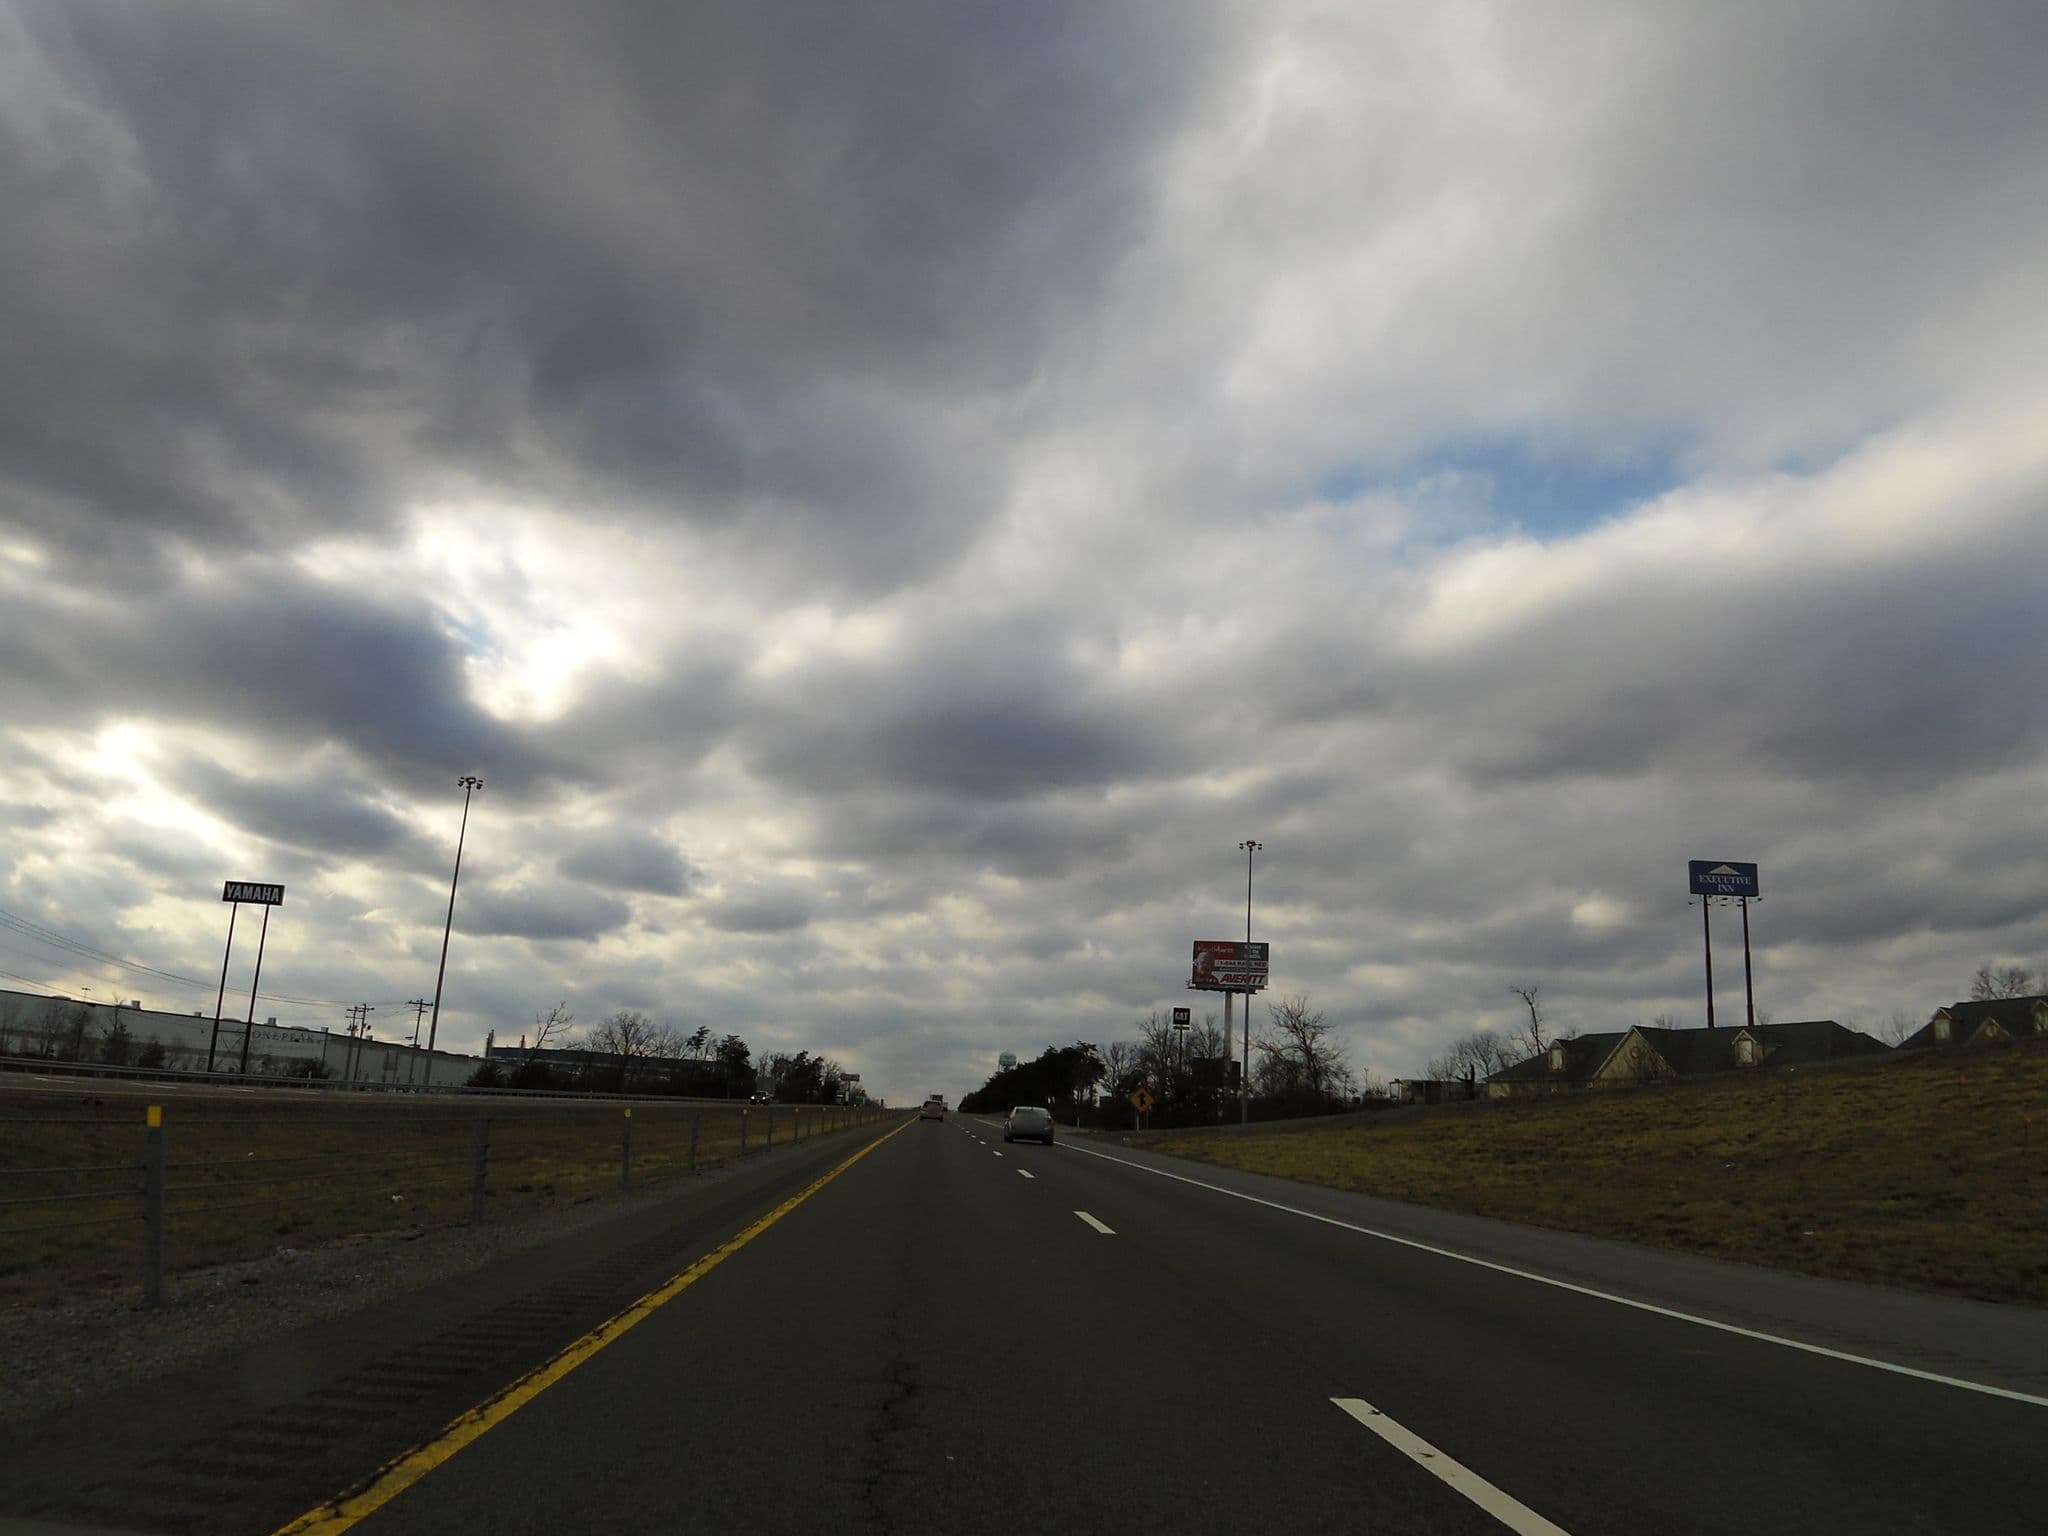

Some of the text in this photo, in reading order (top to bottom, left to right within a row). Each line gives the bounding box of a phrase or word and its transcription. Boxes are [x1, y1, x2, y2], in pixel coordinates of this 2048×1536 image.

[1698, 874, 1752, 885] EXECUTIVE
[226, 883, 280, 902] YAMAHA
[1717, 884, 1735, 893] INN
[1220, 973, 1265, 984] AVERITT
[1175, 1011, 1188, 1021] CAT
